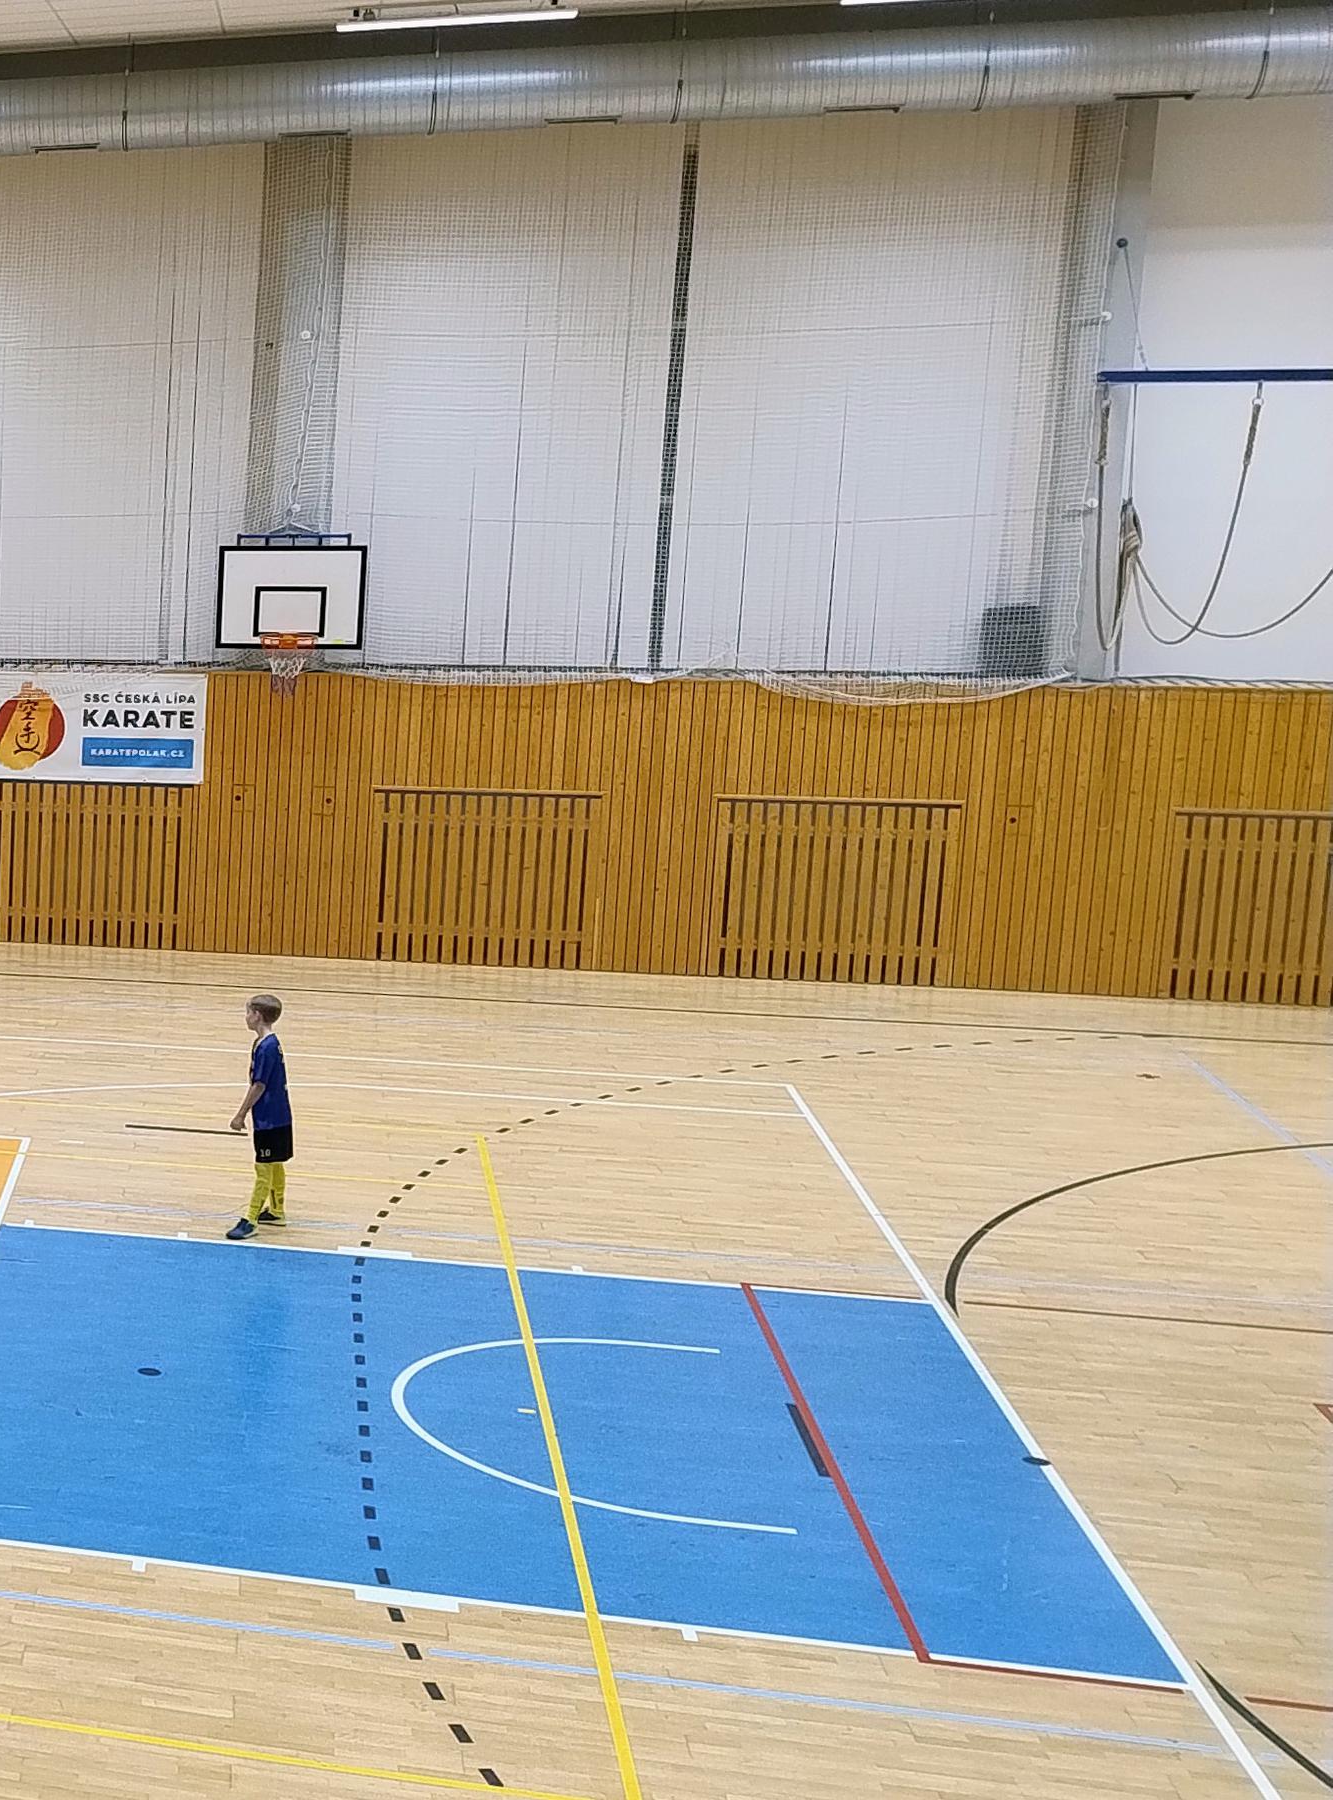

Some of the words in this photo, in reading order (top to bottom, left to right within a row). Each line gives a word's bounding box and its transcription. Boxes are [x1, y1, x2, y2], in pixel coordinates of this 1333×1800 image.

[84, 694, 109, 703] SSC
[115, 691, 161, 704] ČESKÁ
[166, 692, 195, 704] LÍPA
[83, 709, 194, 729] KARATE
